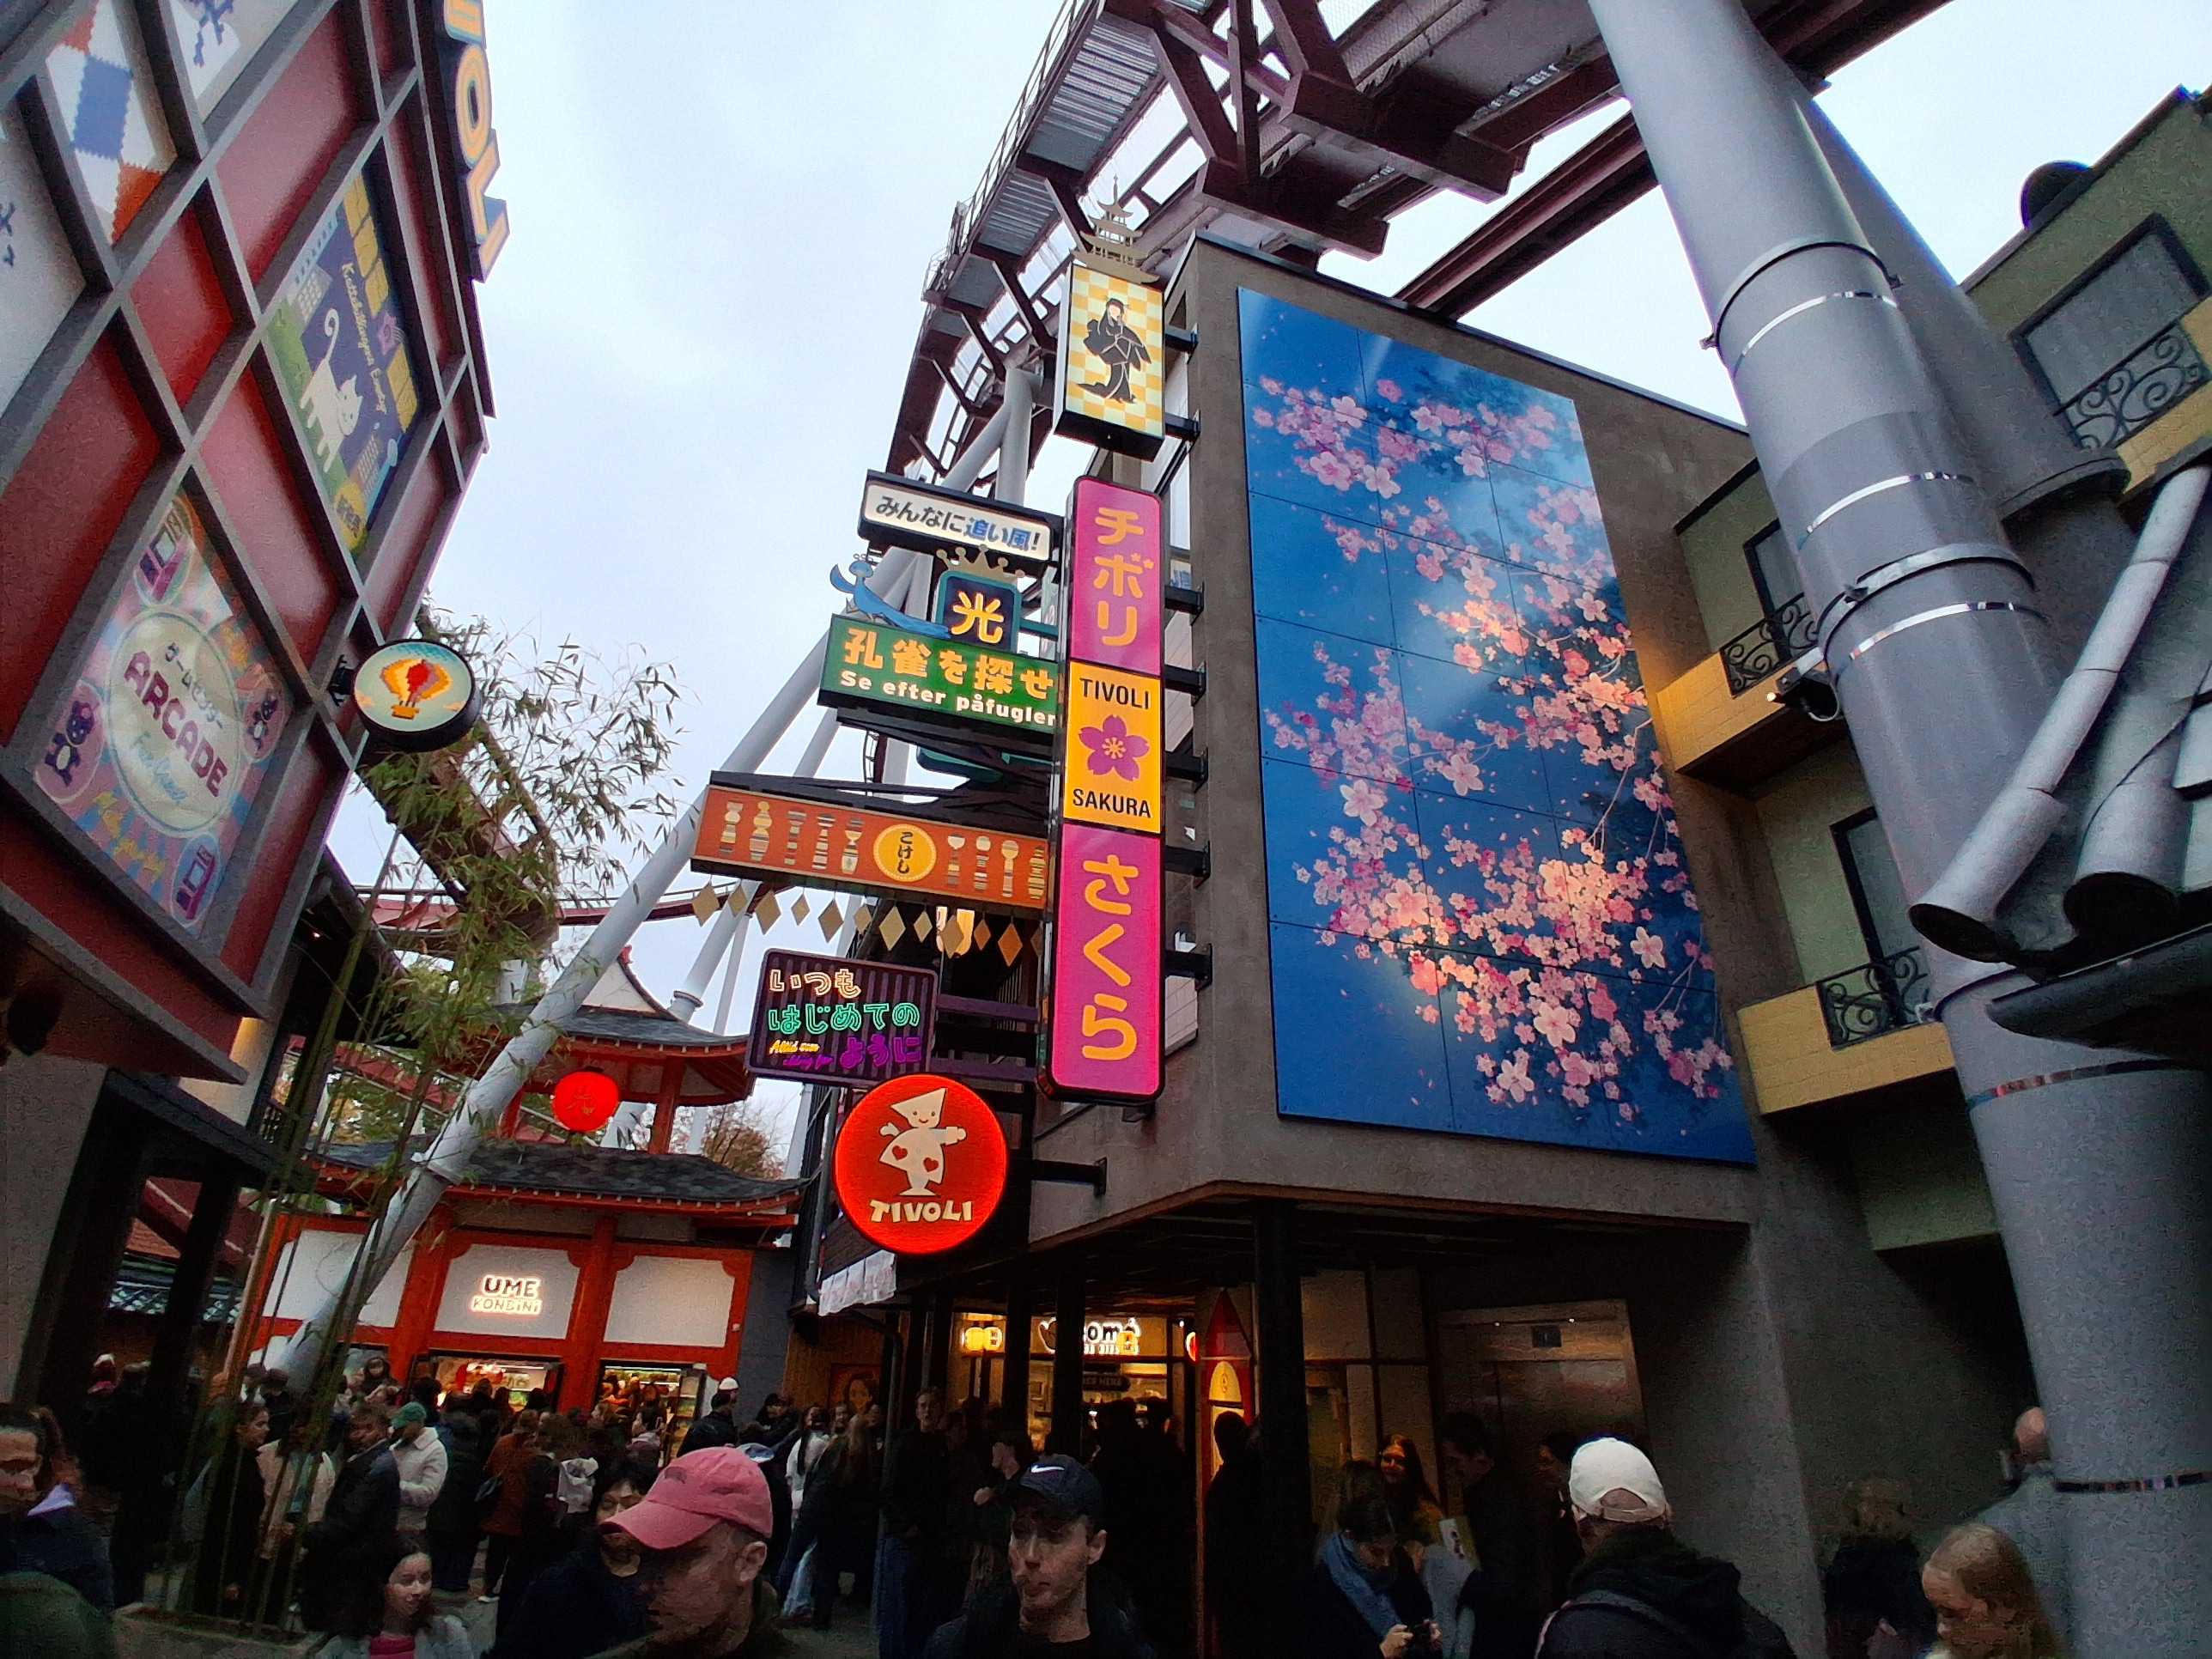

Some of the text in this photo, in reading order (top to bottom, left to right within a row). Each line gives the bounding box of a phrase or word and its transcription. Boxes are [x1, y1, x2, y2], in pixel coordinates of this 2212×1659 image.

[876, 495, 1041, 551] みんなに追い風!
[1093, 507, 1154, 647] チボリ
[951, 590, 1005, 644] 光
[844, 628, 1054, 700] 孔雀を探せ
[840, 670, 1055, 726] Se efter påfugler
[1079, 677, 1151, 711] TIVOLI
[124, 651, 228, 798] ARCADE
[1073, 787, 1152, 818] SAKURA
[897, 831, 914, 874] こけし
[1082, 854, 1139, 1060] さくら
[769, 969, 861, 999] いつも
[768, 1002, 920, 1035] はじめての
[840, 1033, 922, 1068] ように
[869, 1199, 972, 1223] TIVOLI
[483, 1276, 538, 1297] UME
